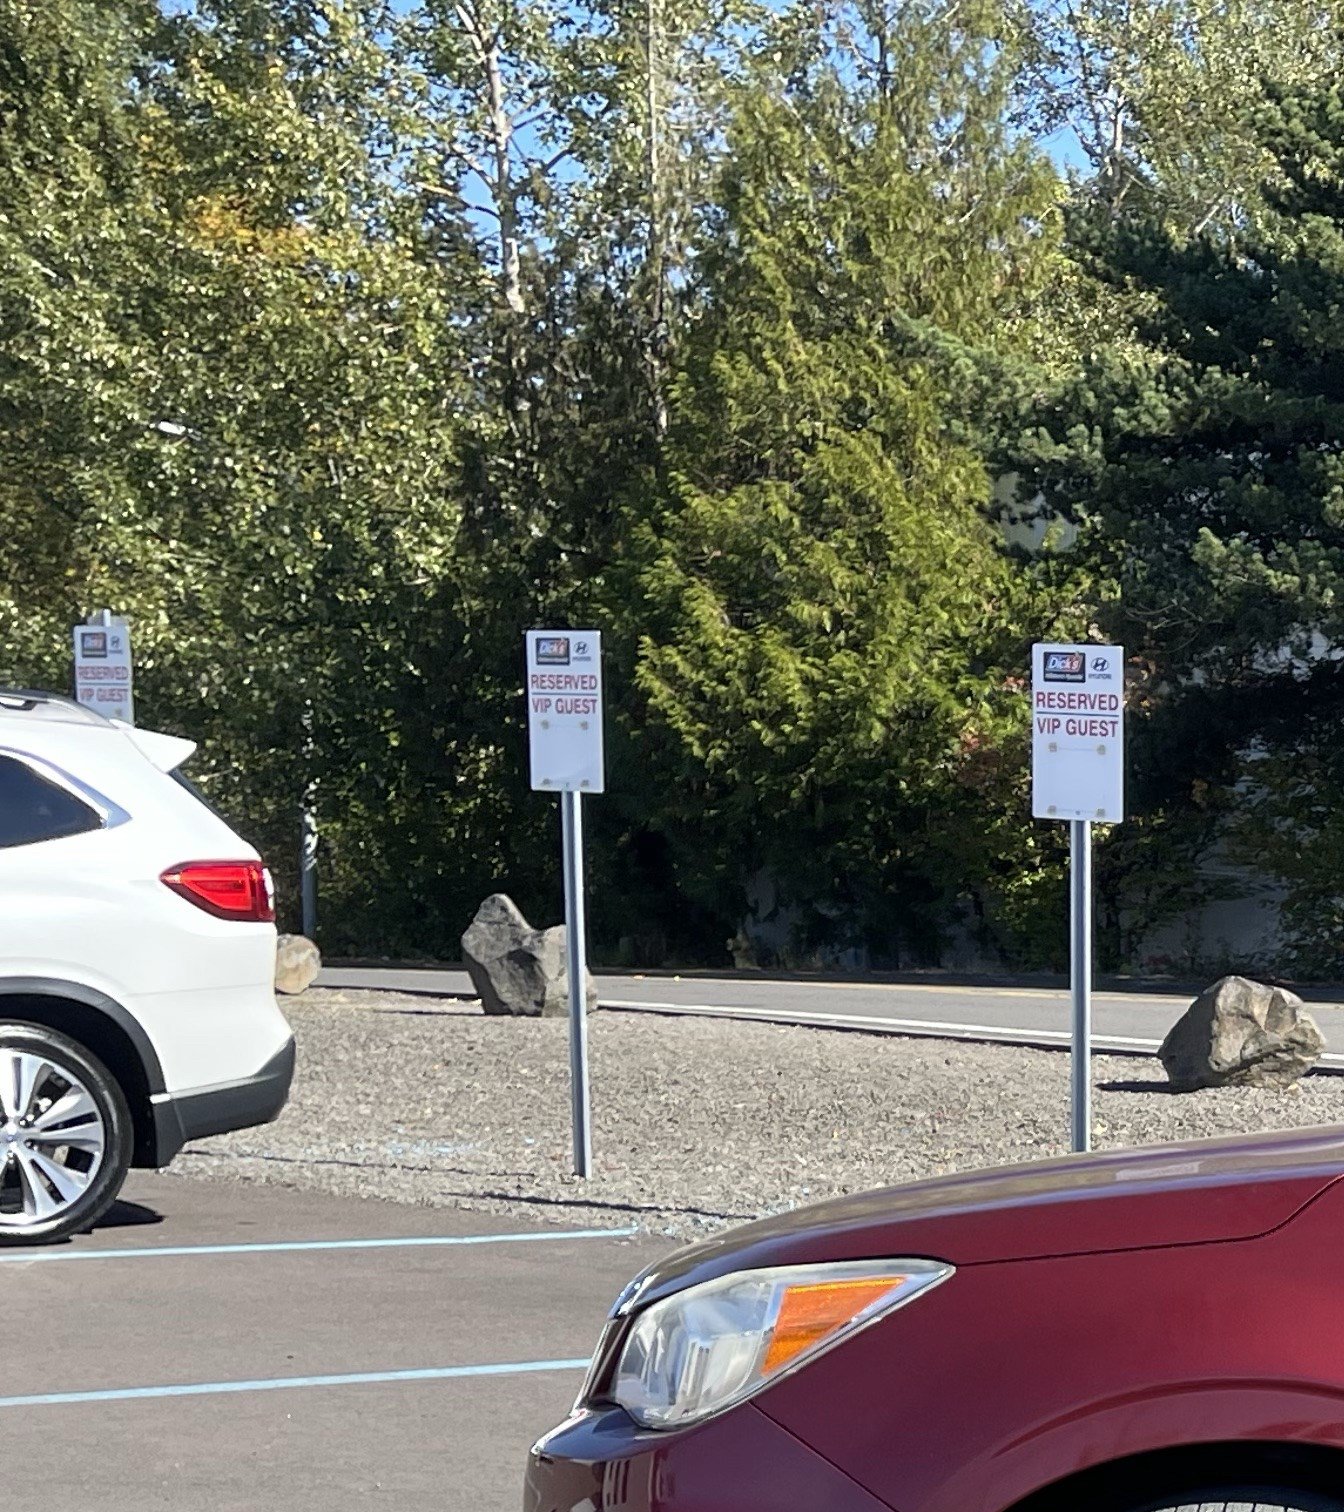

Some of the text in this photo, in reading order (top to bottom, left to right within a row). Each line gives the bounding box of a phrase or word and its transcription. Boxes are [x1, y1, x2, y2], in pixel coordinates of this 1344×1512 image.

[530, 674, 597, 690] RESERVED
[531, 697, 597, 715] VIP GUEST
[1036, 691, 1119, 711] RESERVED
[1036, 717, 1119, 738] VIP GUEST
